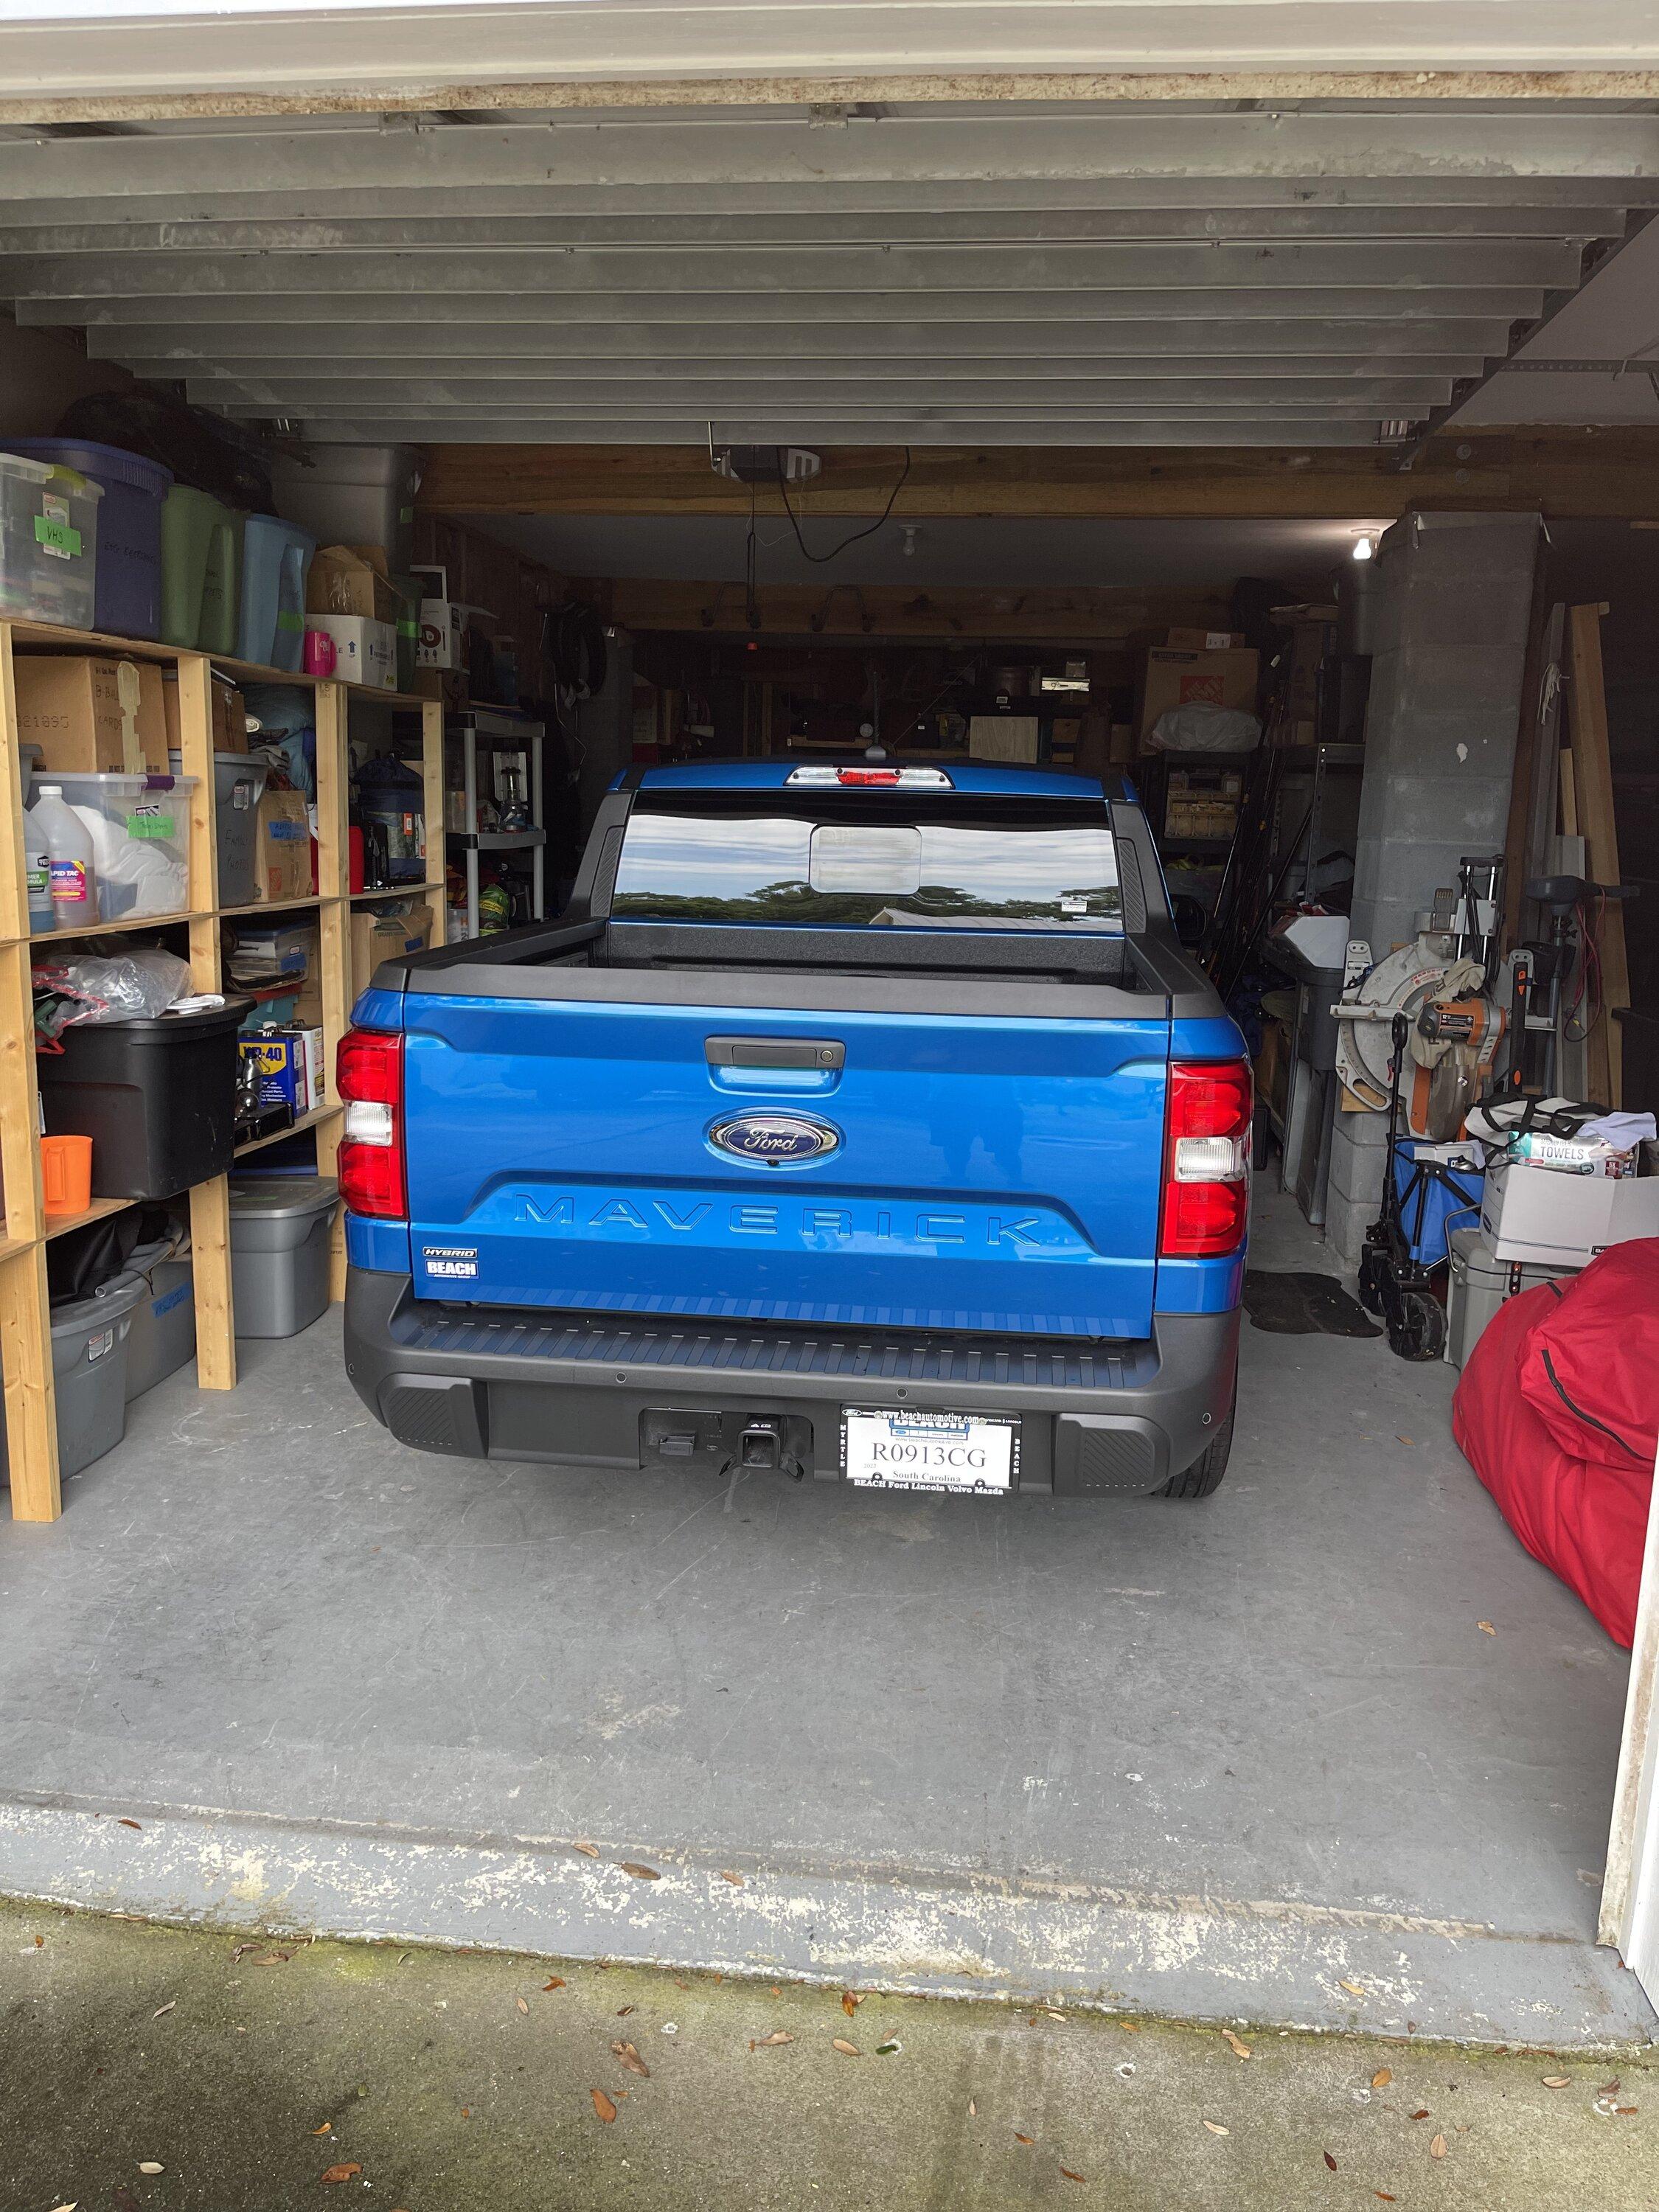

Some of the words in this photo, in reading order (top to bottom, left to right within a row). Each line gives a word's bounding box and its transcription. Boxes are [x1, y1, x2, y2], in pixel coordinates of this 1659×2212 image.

[46, 526, 64, 543] VHS
[744, 1127, 798, 1152] Ford
[1540, 1147, 1585, 1161] TOWELS
[514, 1193, 1041, 1248] MAVERICK
[425, 1248, 476, 1257] HYBRID
[427, 1261, 477, 1276] BEACH
[882, 1409, 979, 1425] www.beachautomotive.com
[839, 1424, 847, 1467] MYRTLE
[872, 1442, 987, 1468] R0913CG
[1012, 1438, 1021, 1475] BEACH
[893, 1470, 919, 1481] South
[922, 1472, 961, 1483] Carolina
[853, 1479, 886, 1488] BEACH
[911, 1483, 946, 1492] Lincoln
[947, 1485, 973, 1494] Volvo
[974, 1486, 1004, 1495] Mazda
